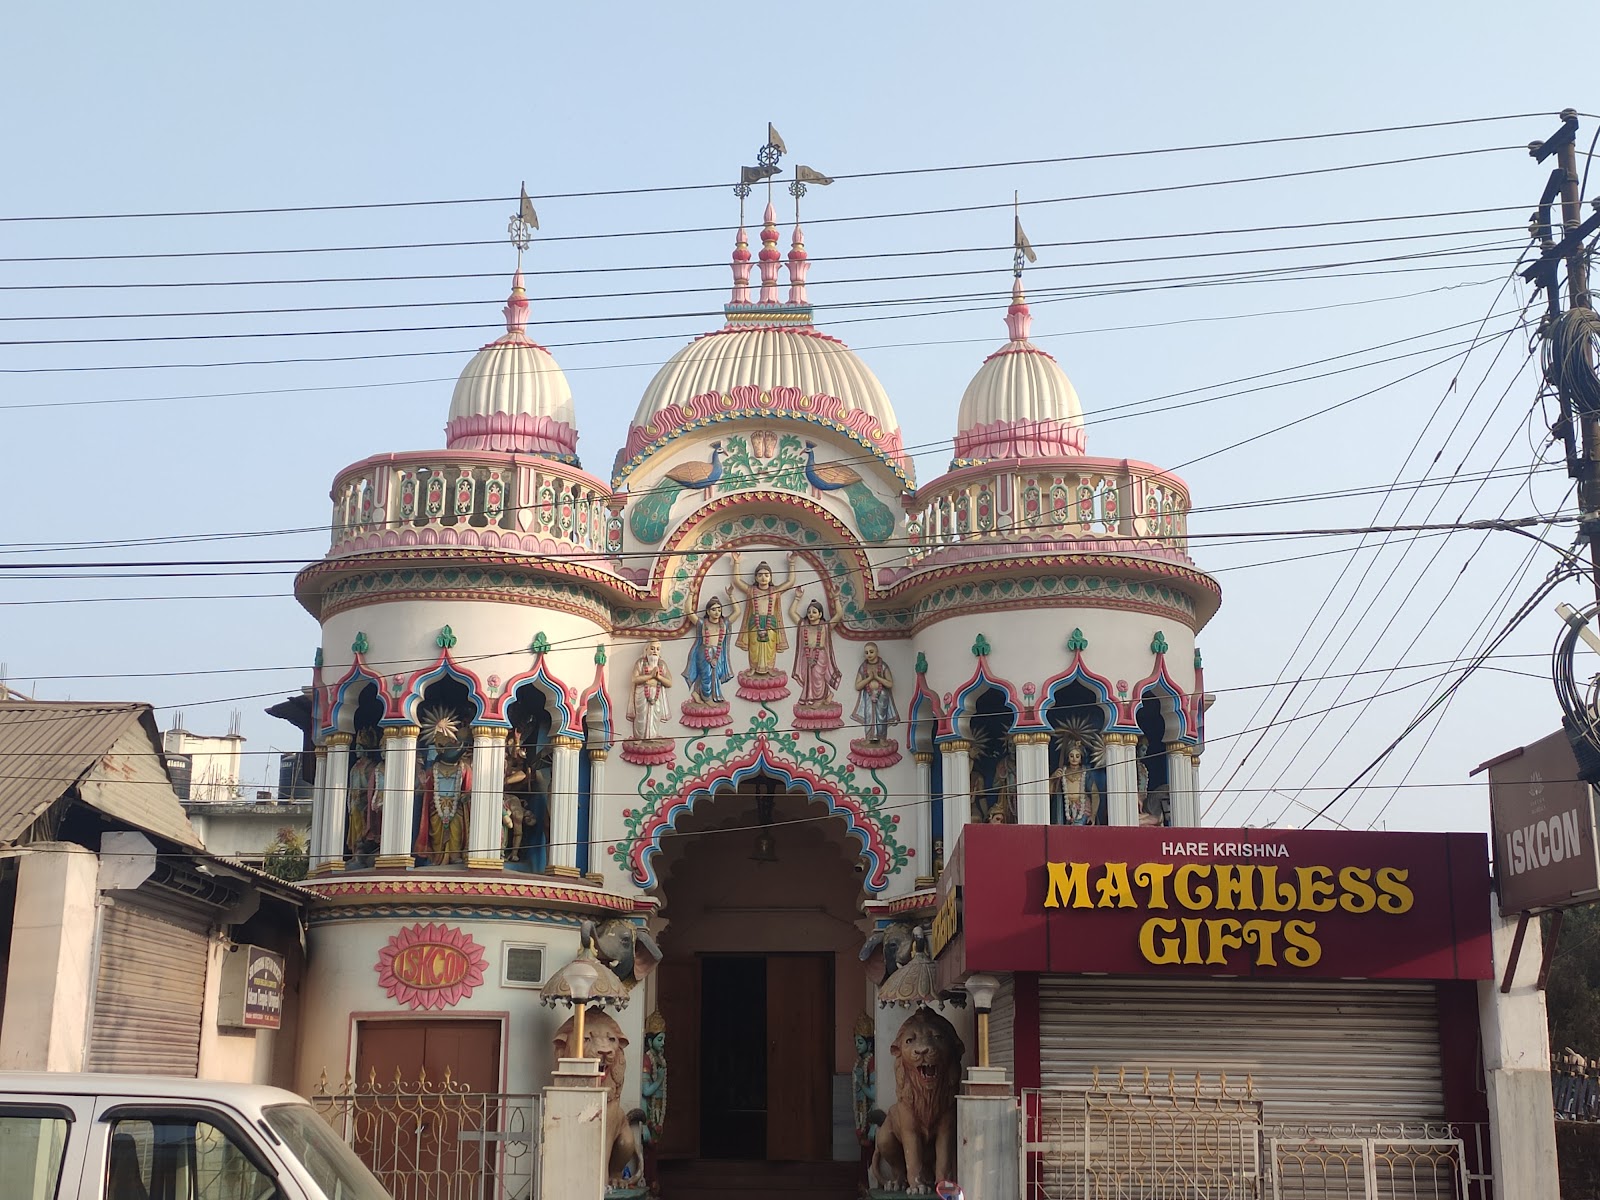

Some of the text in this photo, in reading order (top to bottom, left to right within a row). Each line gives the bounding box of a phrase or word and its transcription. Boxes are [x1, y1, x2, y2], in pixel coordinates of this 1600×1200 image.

[1161, 842, 1290, 858] HARE KRISHNA
[1506, 808, 1581, 876] ISKCON
[1044, 861, 1415, 914] MATCHLESS
[398, 946, 466, 985] ISKCON
[1139, 917, 1322, 968] GIFTS
